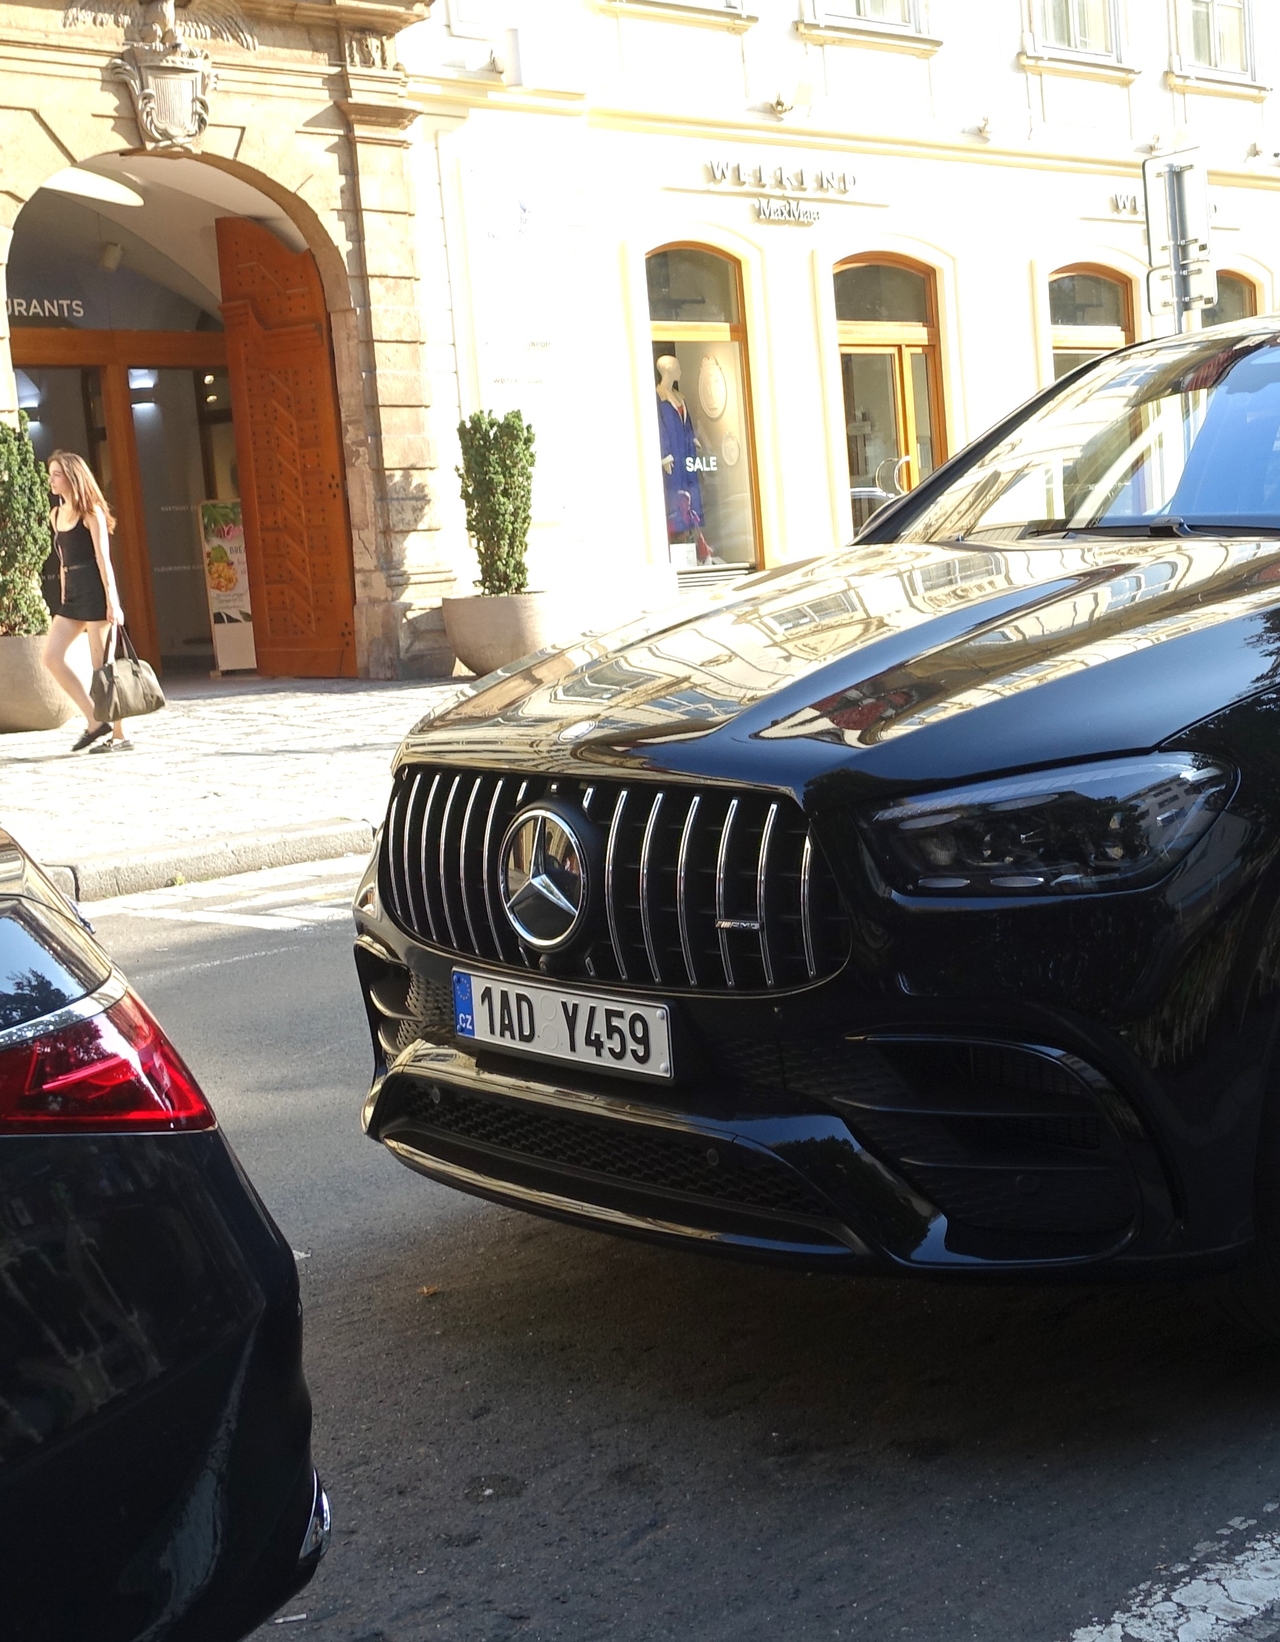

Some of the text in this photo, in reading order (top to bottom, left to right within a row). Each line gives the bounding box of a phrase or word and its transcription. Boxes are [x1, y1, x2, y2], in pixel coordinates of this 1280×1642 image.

[685, 456, 718, 473] SALE
[458, 1013, 473, 1030] CZ
[480, 985, 651, 1065] 1AD Y459
